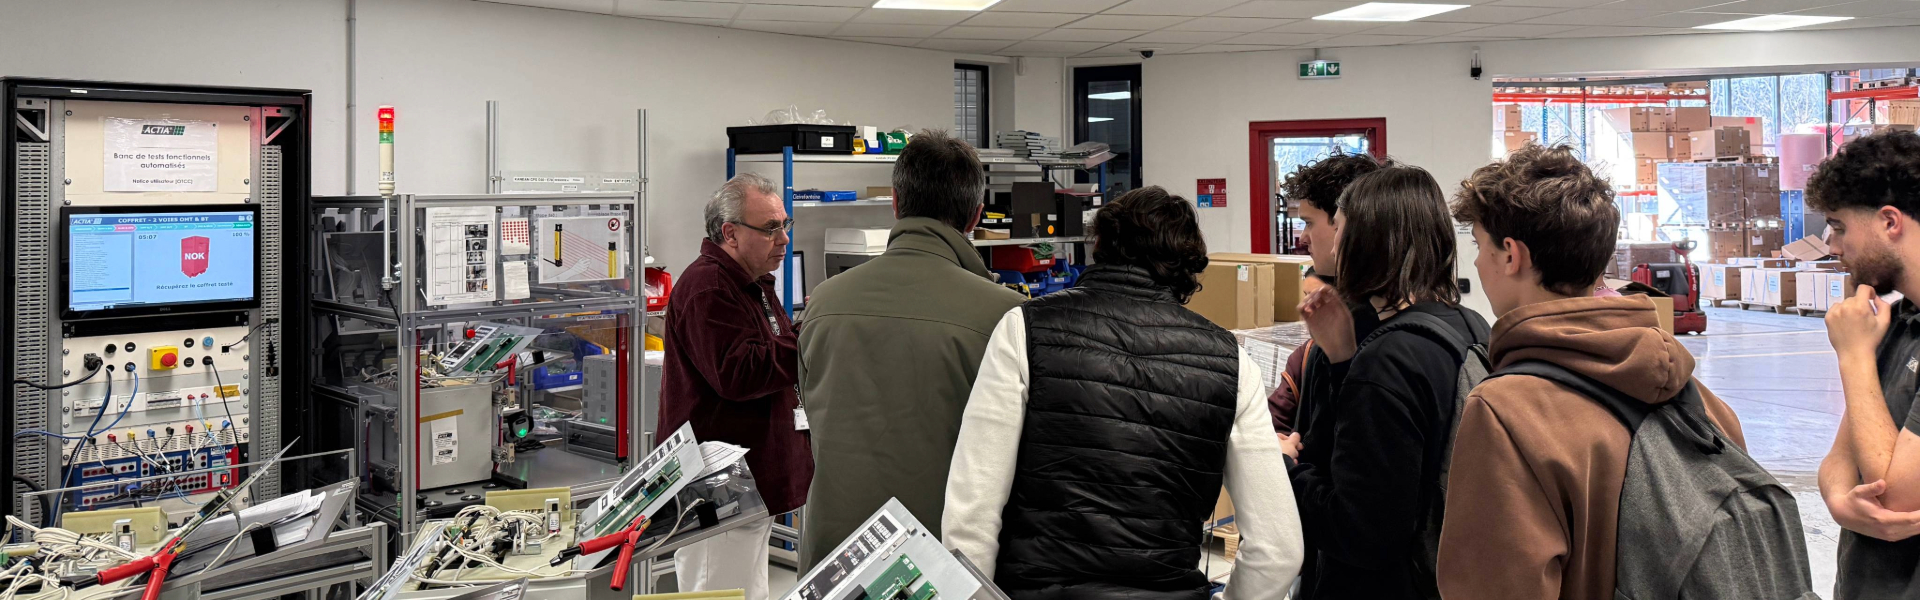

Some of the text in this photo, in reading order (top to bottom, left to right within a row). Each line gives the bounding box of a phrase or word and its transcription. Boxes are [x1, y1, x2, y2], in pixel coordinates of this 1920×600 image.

[144, 125, 170, 134] ACTIA
[135, 152, 146, 160] de
[166, 153, 211, 161] fonctionnels
[140, 161, 186, 169] automatisés
[184, 252, 205, 260] NOK
